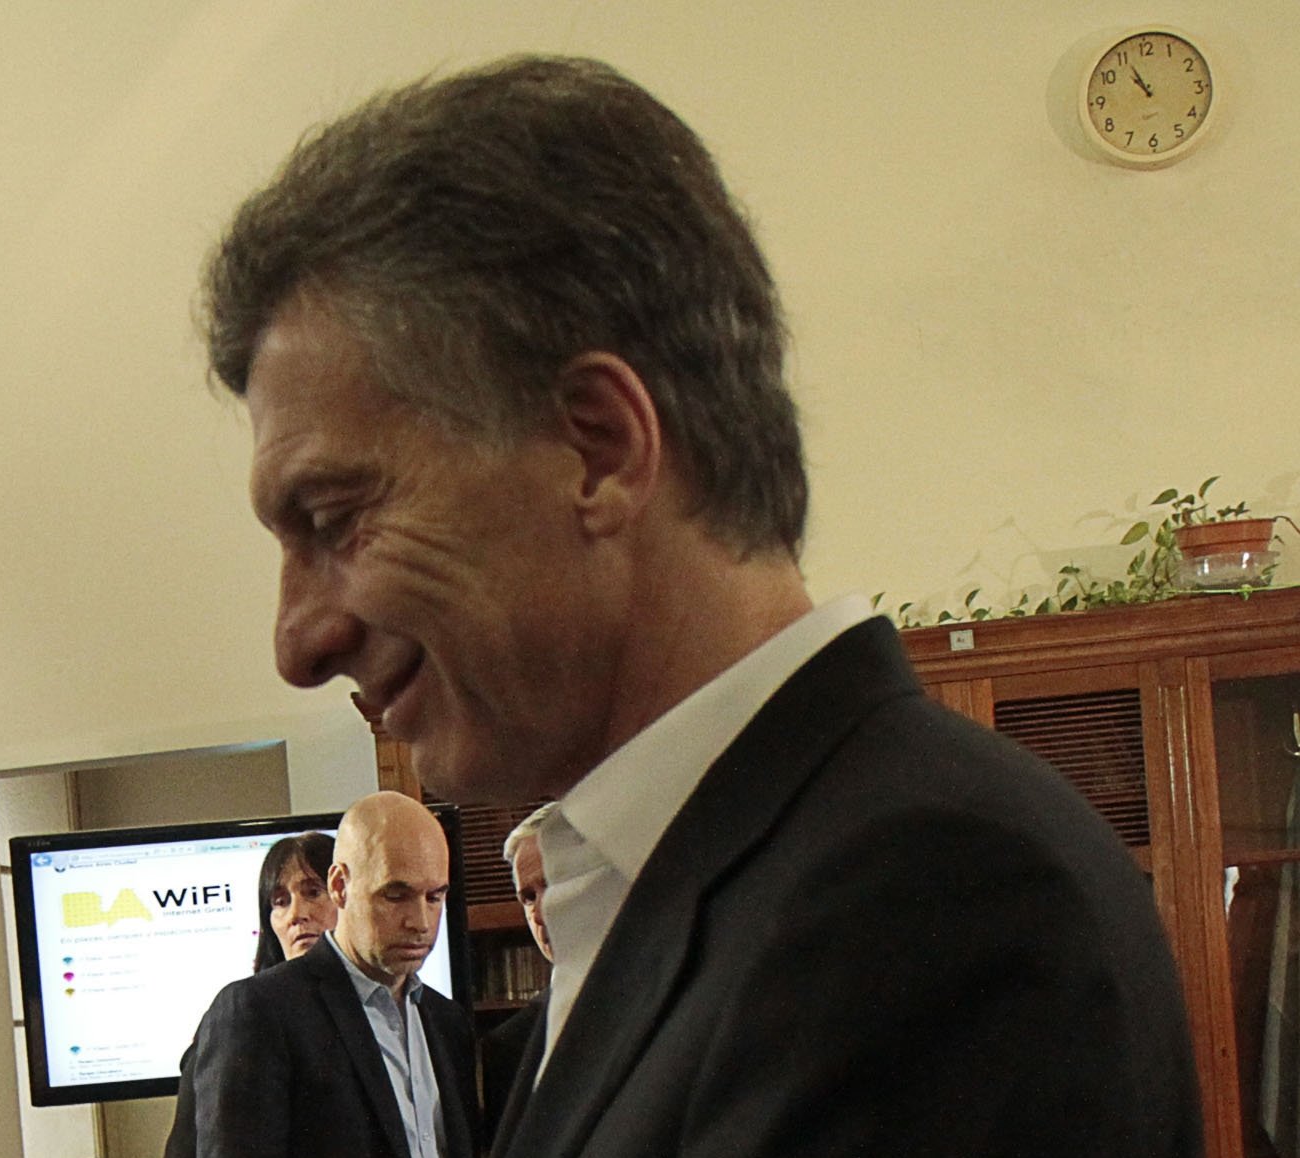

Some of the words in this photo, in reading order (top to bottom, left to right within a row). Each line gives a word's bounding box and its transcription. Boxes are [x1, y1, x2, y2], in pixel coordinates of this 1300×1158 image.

[1139, 41, 1153, 57] 12
[1166, 43, 1172, 58] 1
[1117, 51, 1128, 66] 11
[1183, 57, 1194, 72] 2
[1101, 69, 1116, 85] 10
[1193, 80, 1204, 94] 3
[1095, 96, 1106, 110] 9
[1187, 105, 1197, 118] 4
[1105, 117, 1115, 132] 8
[1174, 123, 1184, 138] 5
[1124, 131, 1134, 146] 7
[1148, 133, 1158, 147] 6
[153, 883, 232, 908] WiFi
[162, 907, 201, 918] Internet
